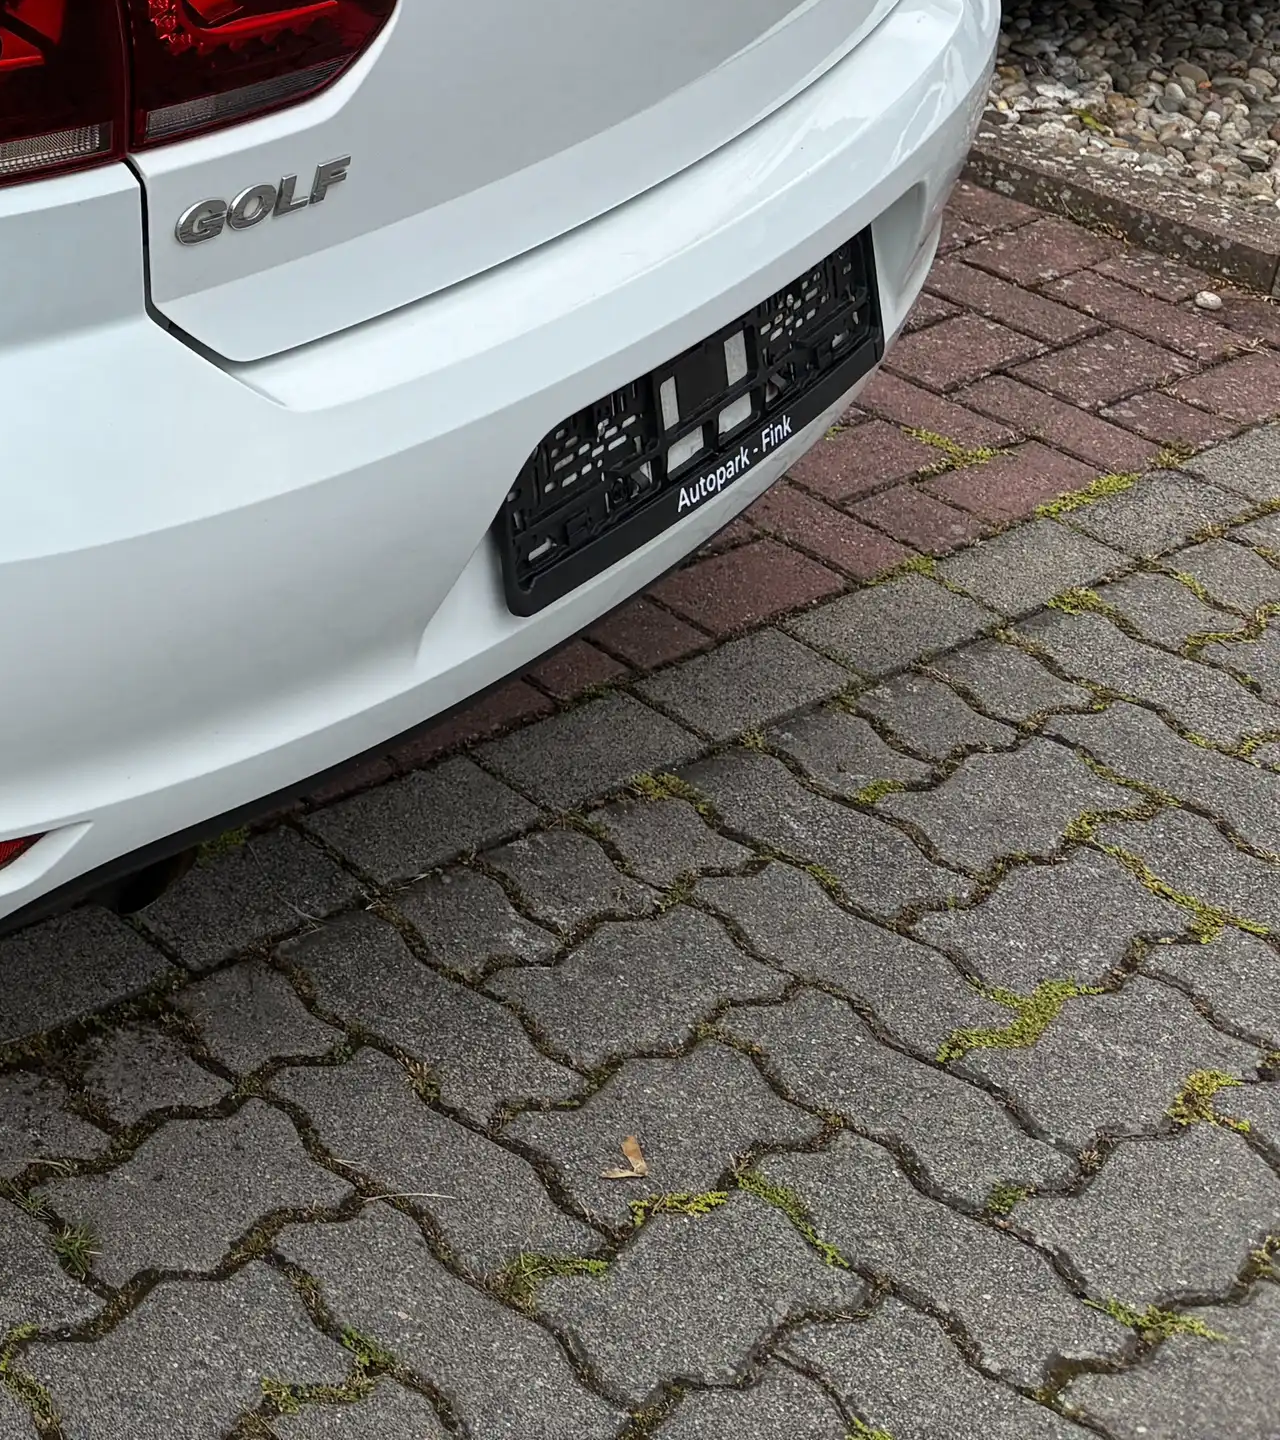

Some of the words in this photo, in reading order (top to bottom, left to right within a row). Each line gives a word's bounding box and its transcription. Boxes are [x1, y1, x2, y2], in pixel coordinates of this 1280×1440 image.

[174, 154, 353, 246] GOLF
[678, 446, 751, 513] Autopark
[761, 414, 792, 453] Fink
